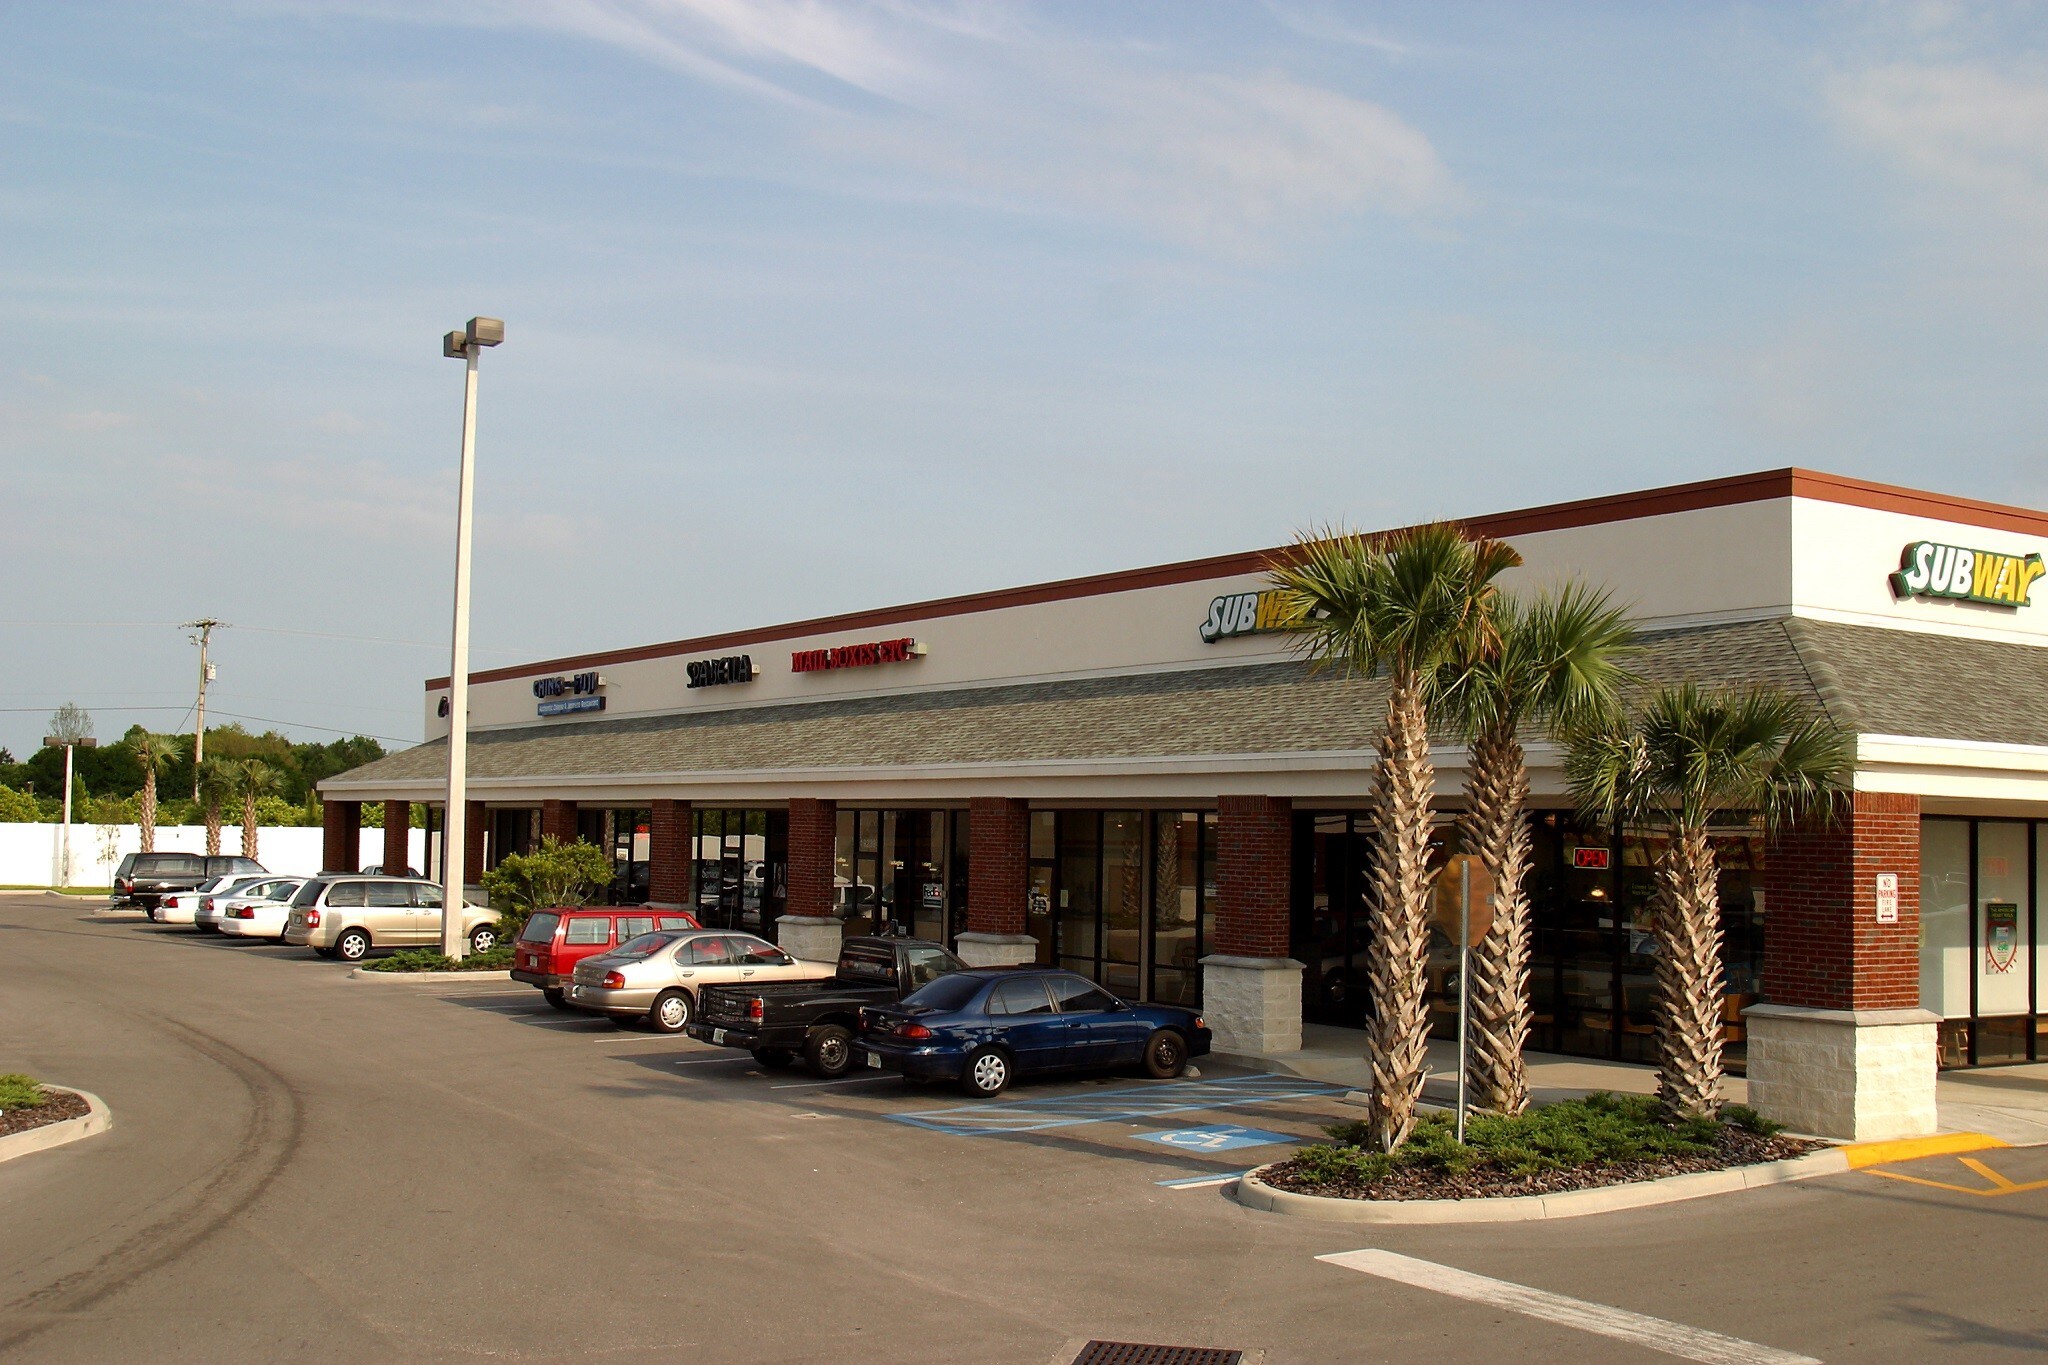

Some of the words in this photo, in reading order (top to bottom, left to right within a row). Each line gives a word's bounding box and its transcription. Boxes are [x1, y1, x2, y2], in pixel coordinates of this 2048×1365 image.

[1903, 542, 2046, 604] SUBWAY
[1200, 589, 1313, 638] SUBWA
[791, 649, 829, 672] MAIL
[830, 642, 880, 669] BOXES
[1576, 850, 1607, 867] OPEN
[1878, 889, 1896, 898] PARKING
[1883, 878, 1891, 888] NO
